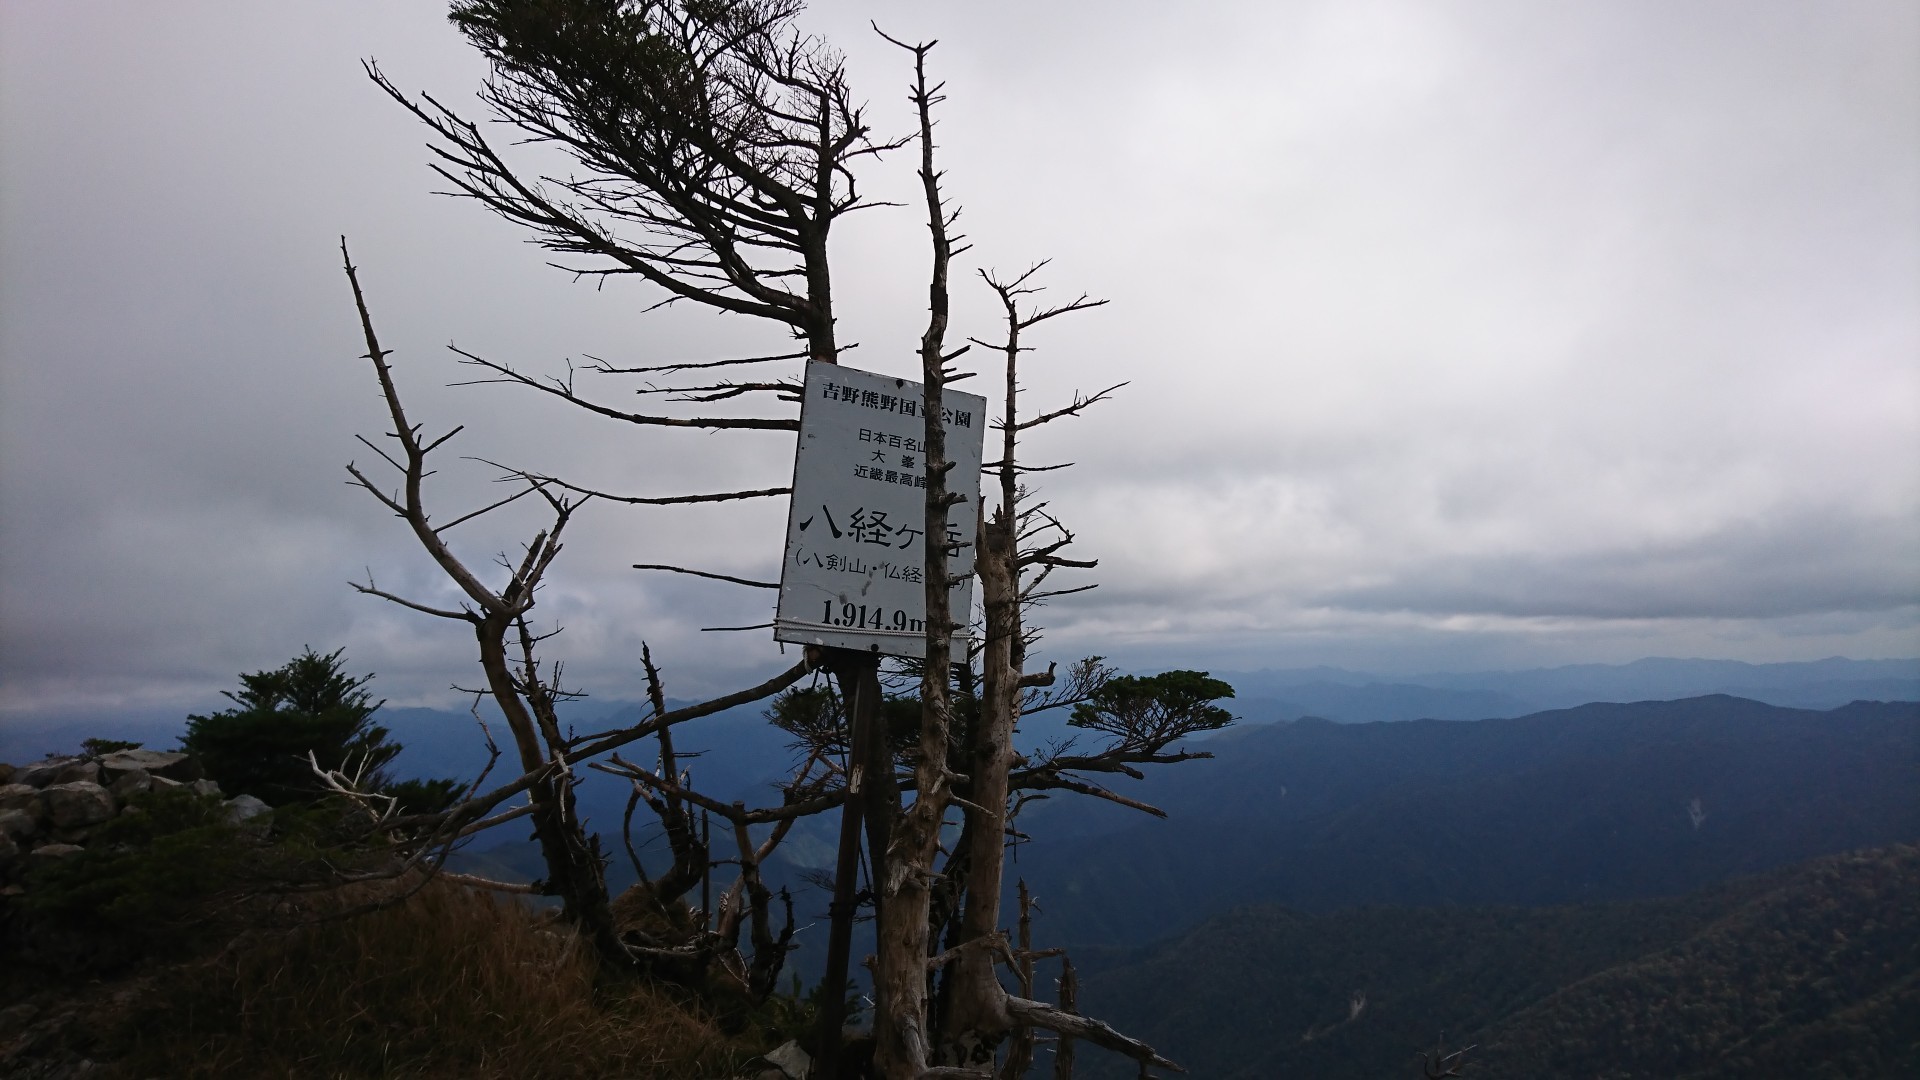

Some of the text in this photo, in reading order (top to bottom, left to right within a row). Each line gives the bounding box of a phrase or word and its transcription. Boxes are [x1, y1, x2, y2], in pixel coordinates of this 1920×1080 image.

[822, 382, 972, 428] 吉野熊野国公園
